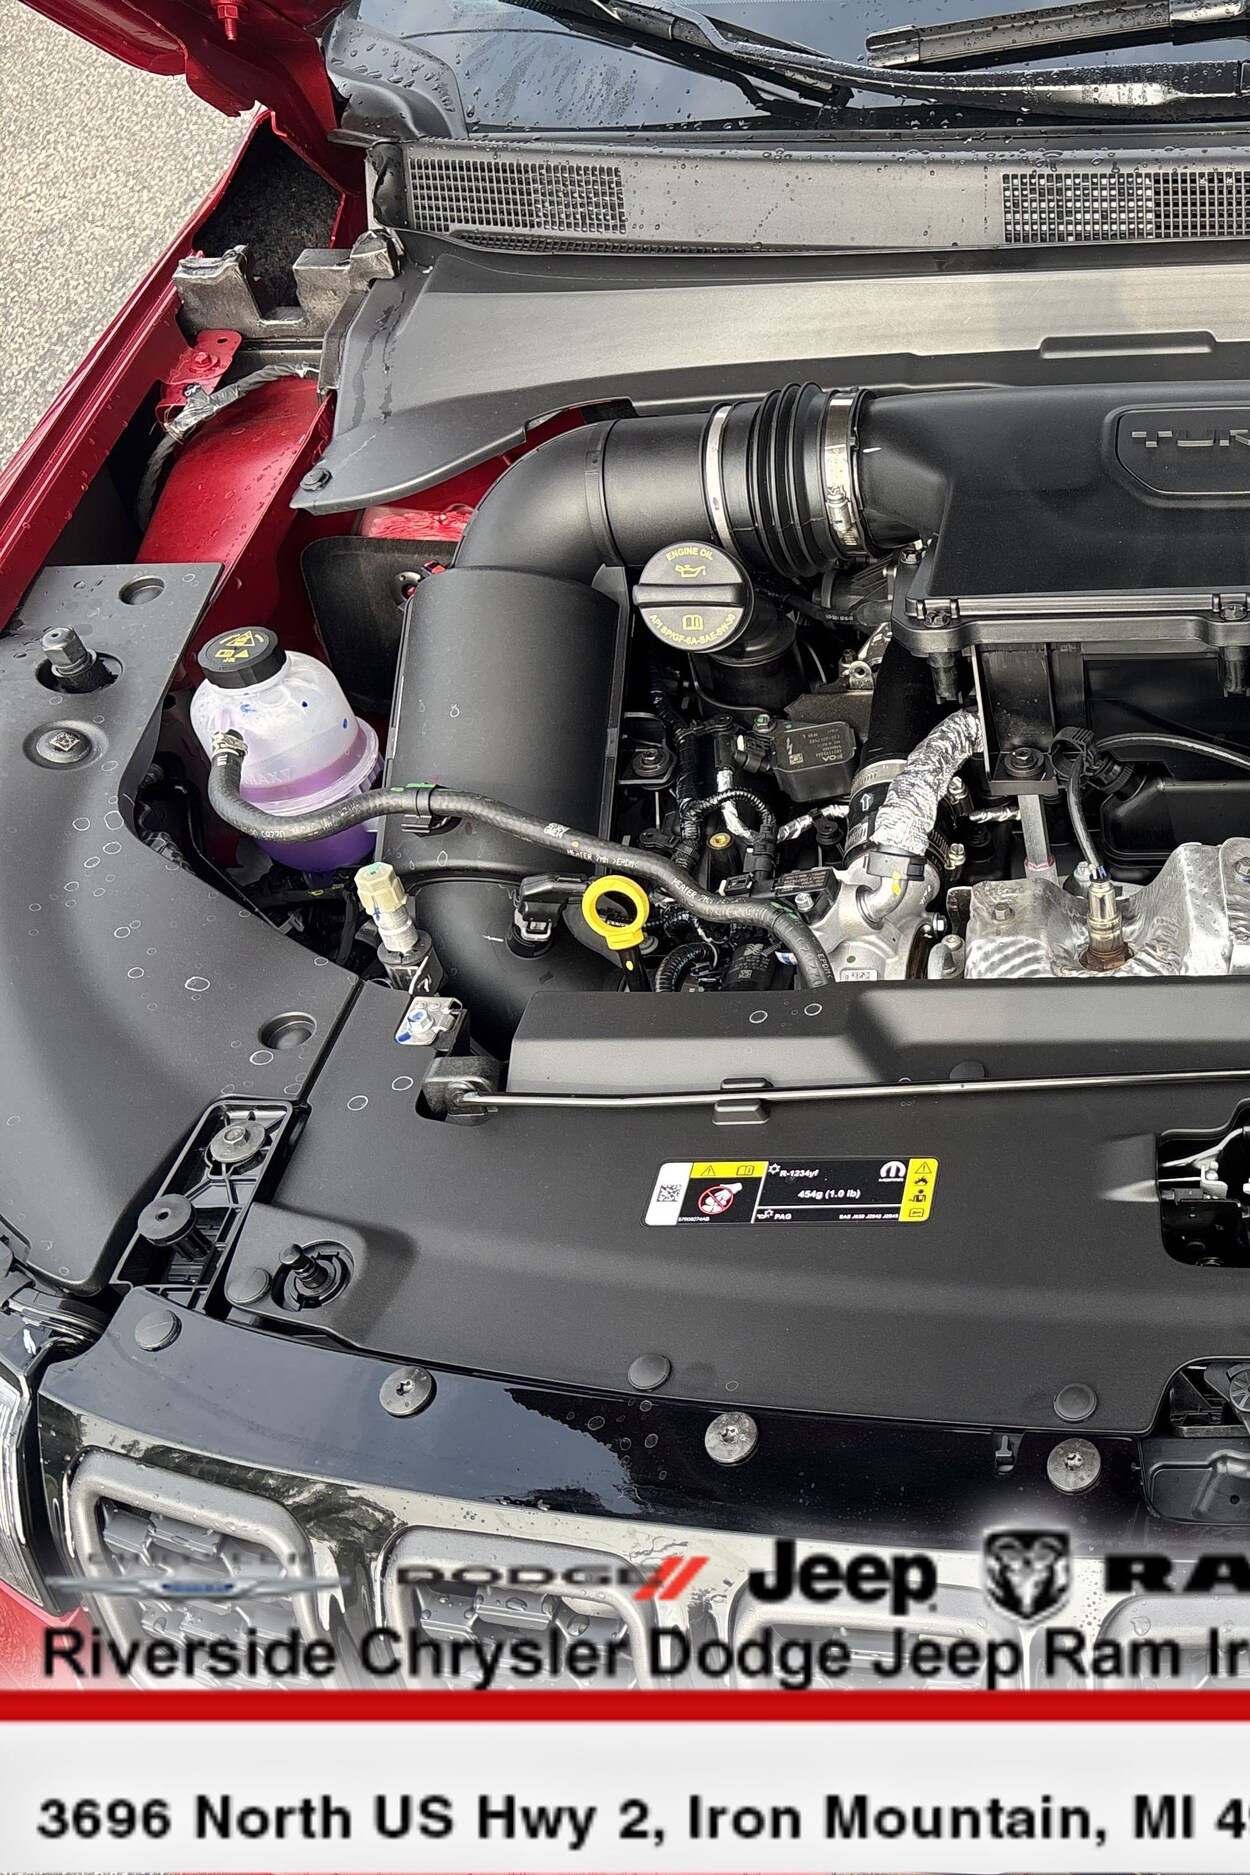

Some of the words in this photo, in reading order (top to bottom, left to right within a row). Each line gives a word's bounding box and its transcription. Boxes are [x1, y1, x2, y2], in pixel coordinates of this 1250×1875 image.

[665, 547, 699, 561] ENGINE
[699, 549, 714, 560] OIL
[649, 614, 664, 629] API
[566, 848, 593, 861] HEATER
[672, 877, 698, 900] HEATER
[780, 1169, 819, 1178] R-1234yf
[798, 1190, 823, 1200] 454g
[825, 1189, 845, 1199] (1.0
[846, 1189, 861, 1199] lb)
